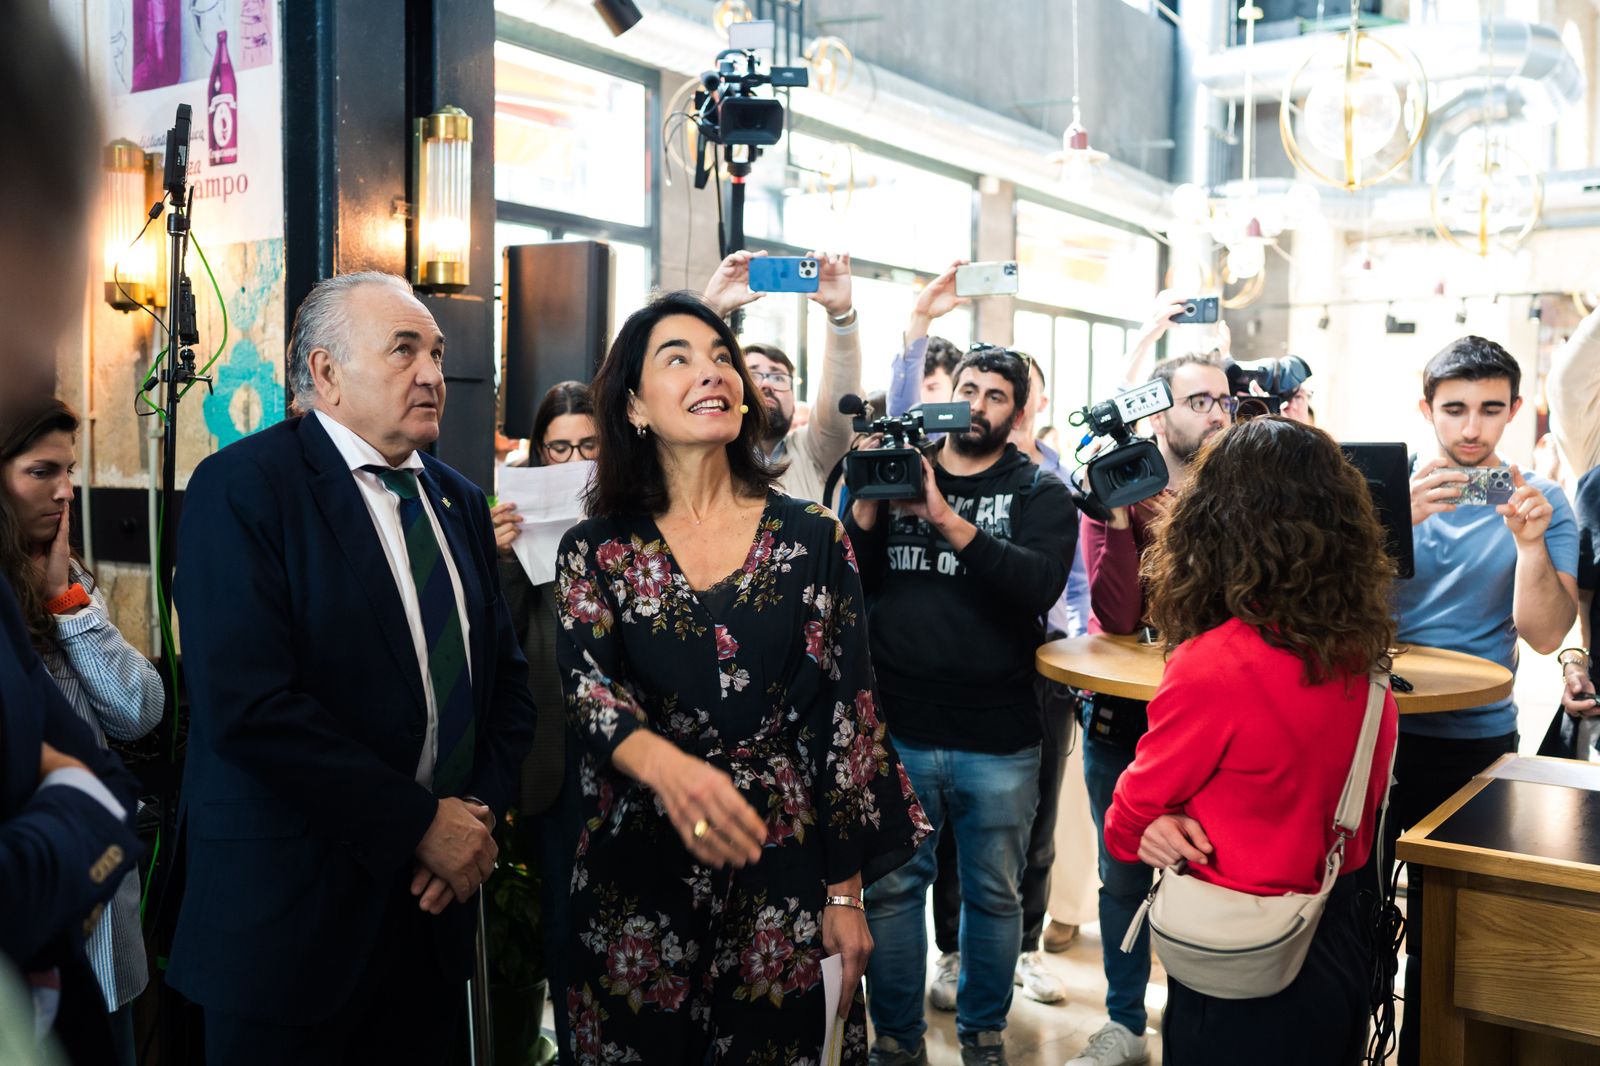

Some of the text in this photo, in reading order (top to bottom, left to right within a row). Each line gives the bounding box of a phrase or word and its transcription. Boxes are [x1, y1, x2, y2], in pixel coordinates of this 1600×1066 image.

[187, 174, 248, 203] ampo
[1127, 400, 1160, 415] SEVILLA
[887, 545, 931, 571] STATE
